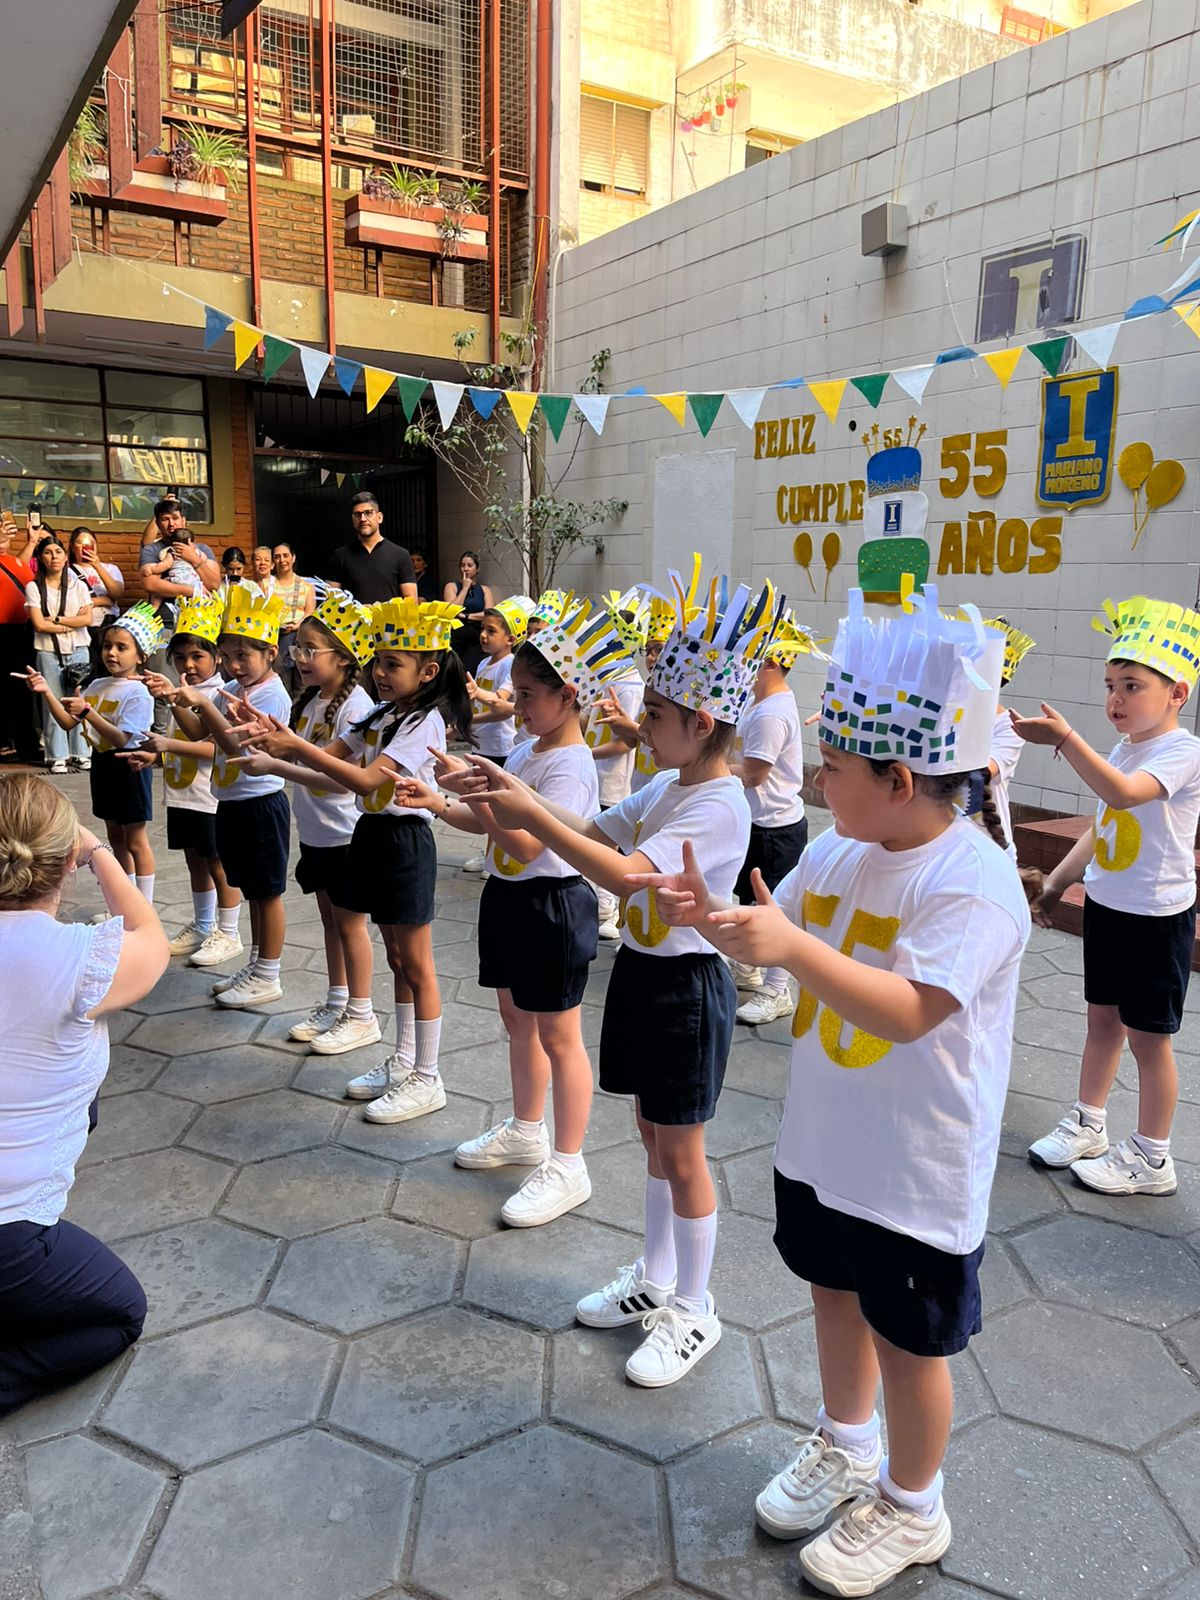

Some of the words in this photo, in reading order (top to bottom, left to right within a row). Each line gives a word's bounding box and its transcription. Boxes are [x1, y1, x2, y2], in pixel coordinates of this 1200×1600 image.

[754, 413, 817, 460] FELIZ
[883, 426, 903, 449] 55
[1055, 375, 1101, 459] I
[939, 429, 1008, 498] 55
[1045, 457, 1102, 478] MARIANO
[1045, 474, 1100, 494] MORENO
[776, 479, 866, 525] CUMPLE
[937, 510, 1063, 576] AÑOS
